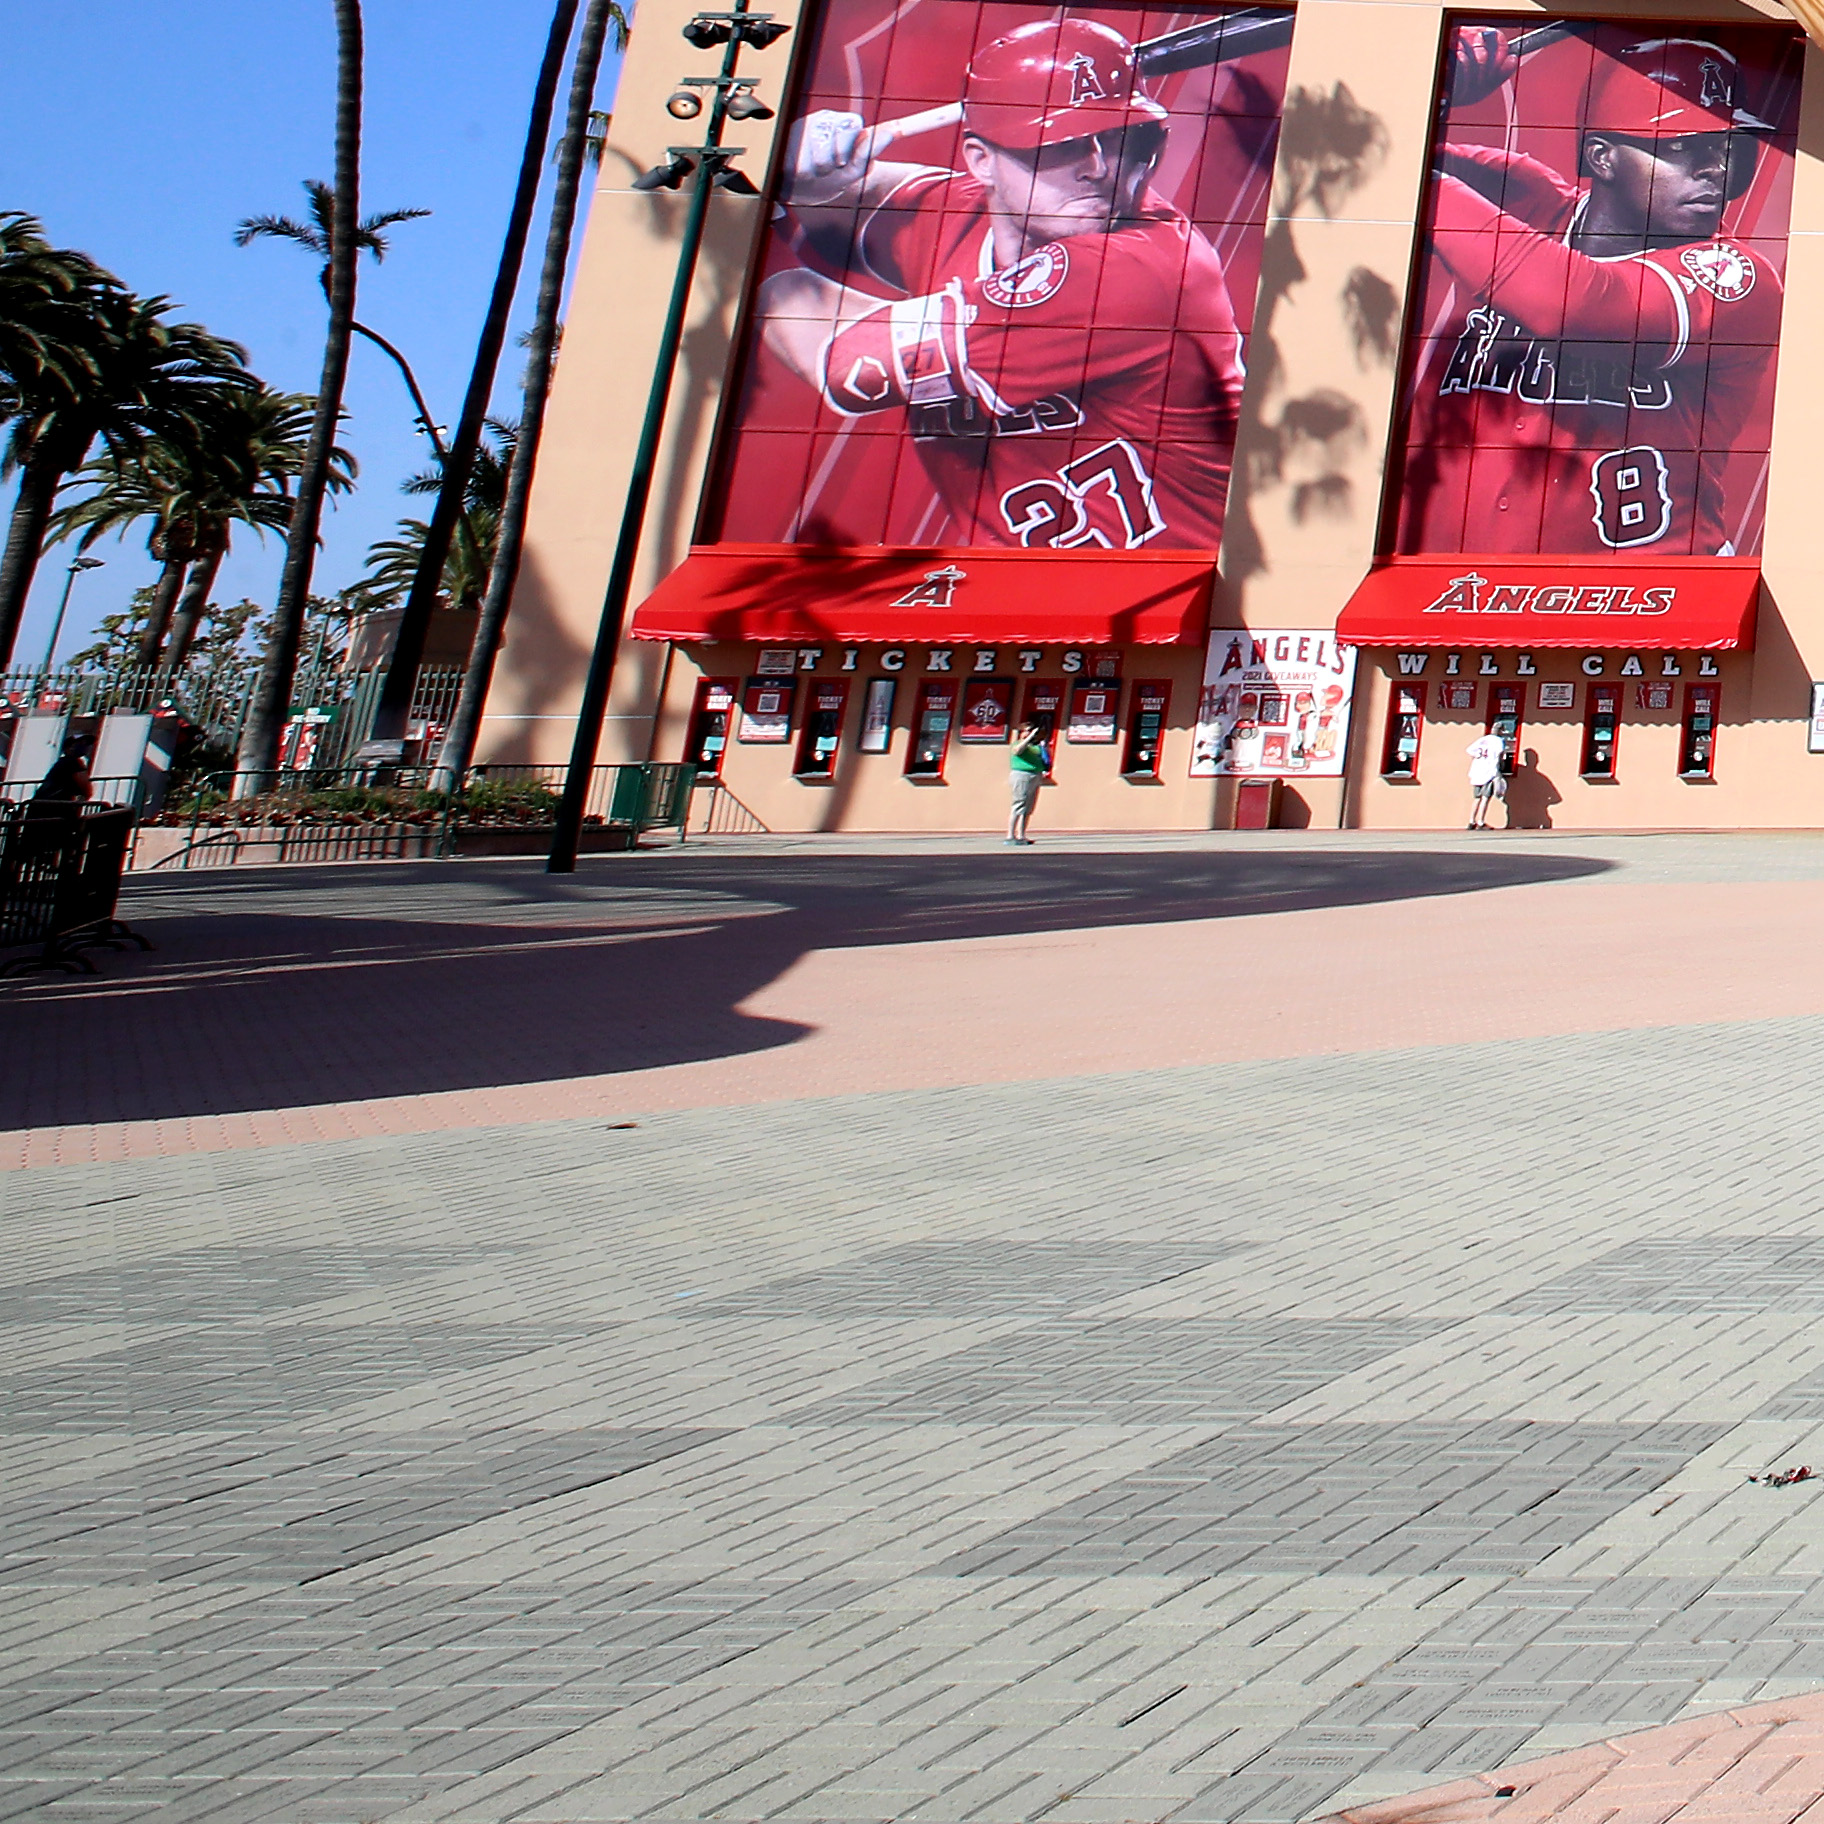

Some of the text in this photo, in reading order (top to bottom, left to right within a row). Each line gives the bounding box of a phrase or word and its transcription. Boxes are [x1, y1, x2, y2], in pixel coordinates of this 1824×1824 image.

[999, 437, 1168, 549] 27
[1589, 445, 1673, 549] 8
[890, 564, 967, 608] A
[1423, 571, 1677, 616] ANGELS
[798, 647, 1084, 673] TICKETS
[1219, 635, 1348, 677] ANGELS
[1242, 671, 1261, 681] 2021
[1397, 652, 1719, 677] WILL CALL
[1477, 747, 1489, 759] 34
